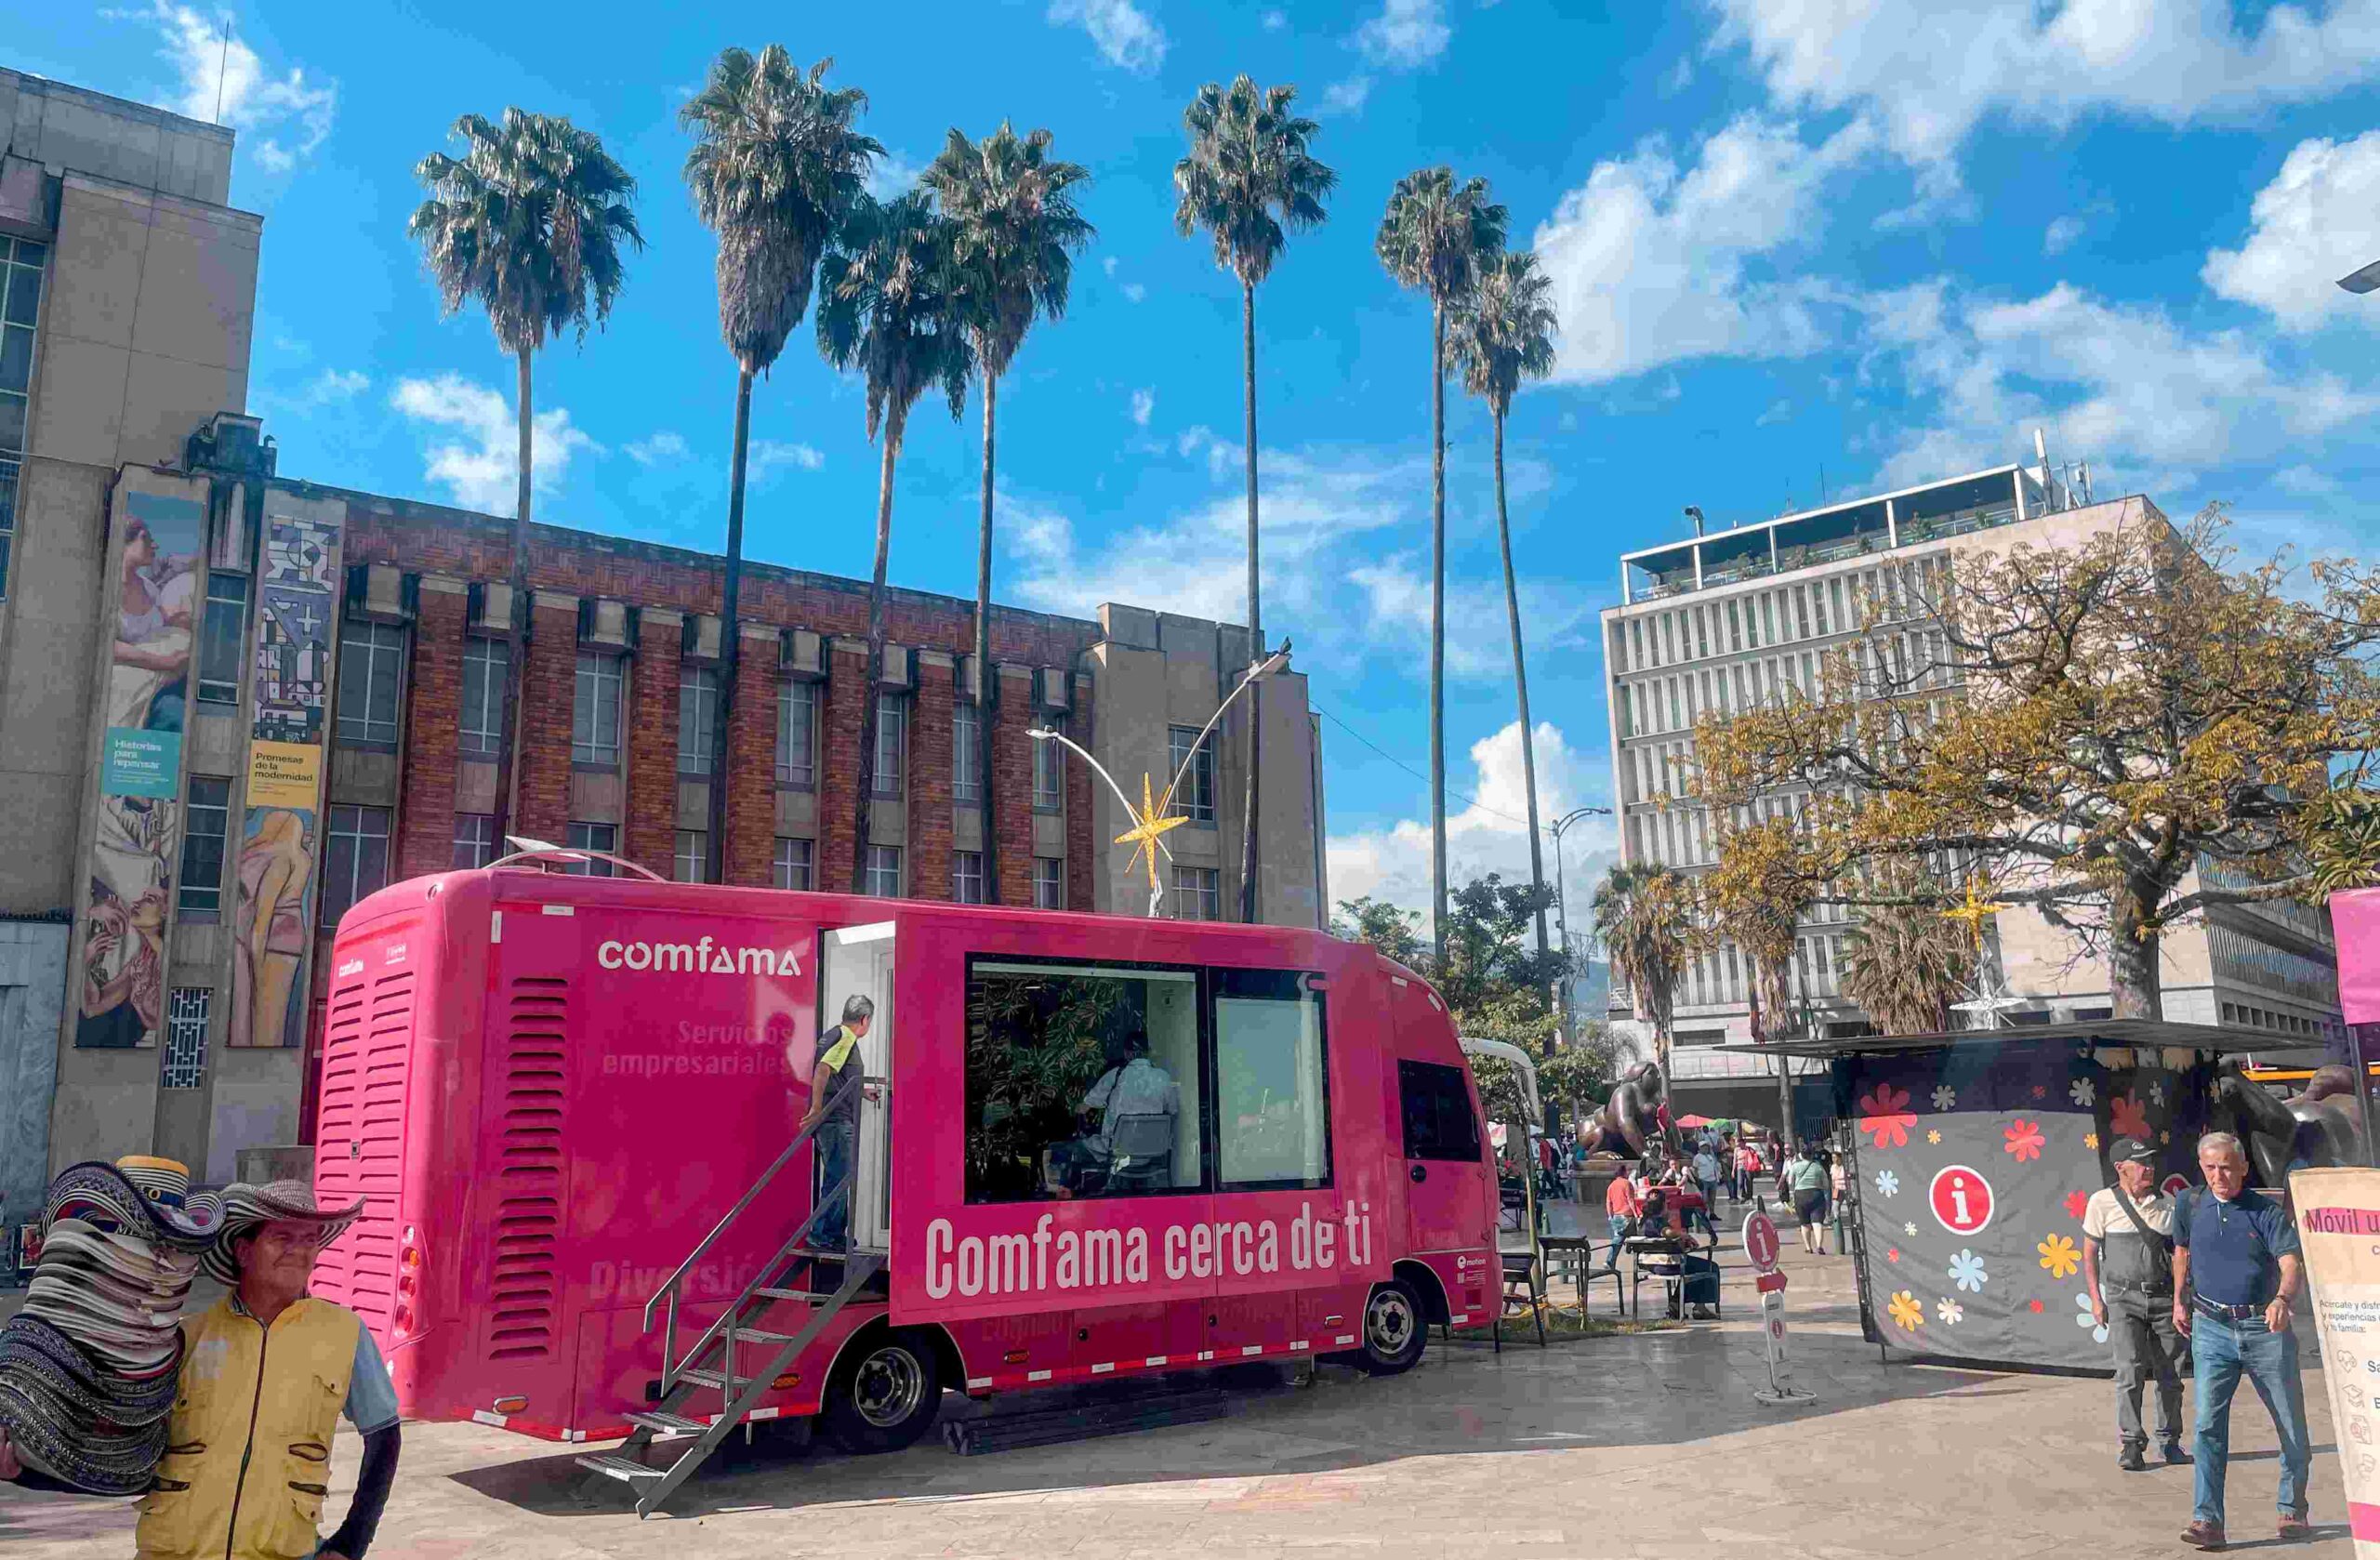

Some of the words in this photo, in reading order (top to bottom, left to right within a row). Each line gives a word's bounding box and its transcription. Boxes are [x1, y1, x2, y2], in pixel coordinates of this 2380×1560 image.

[115, 739, 162, 751] Historias
[256, 752, 304, 764] Promesas
[113, 760, 161, 769] repensar
[255, 761, 268, 770] de
[254, 771, 313, 782] modernidad
[602, 1049, 792, 1078] empresariales
[2306, 1208, 2360, 1234] Móvil
[926, 1213, 1148, 1300] Comfama
[1164, 1220, 1278, 1280] cerca
[1291, 1201, 1334, 1270] de
[1343, 1199, 1372, 1265] ti
[2328, 1313, 2376, 1322] experiencias
